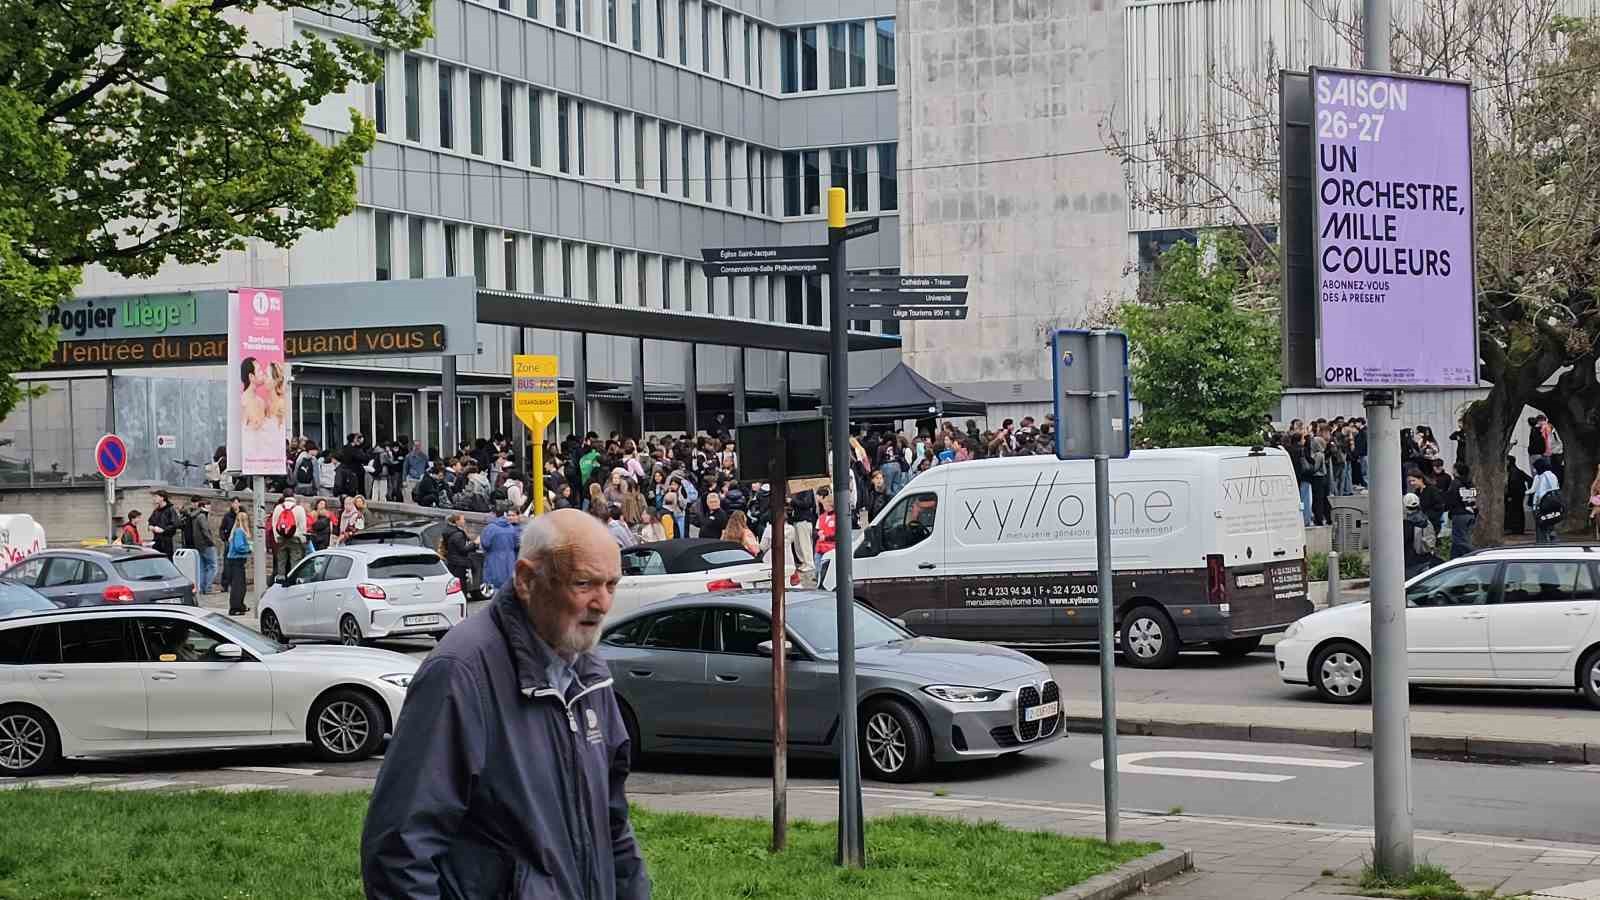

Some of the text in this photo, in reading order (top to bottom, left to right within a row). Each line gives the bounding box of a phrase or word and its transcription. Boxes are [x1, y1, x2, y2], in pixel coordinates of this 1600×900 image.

[1318, 75, 1408, 111] SAISON
[1319, 110, 1385, 142] 26-27
[1320, 143, 1357, 173] UN
[1320, 177, 1465, 216] ORCHESTRE,
[1321, 211, 1397, 242] MILLE
[720, 248, 777, 259] Église Saint-Jacques
[774, 264, 817, 272] Philharmonique
[1321, 245, 1451, 277] COULEURS
[1322, 279, 1390, 291] ABONNEZ-VOUS
[120, 297, 181, 334] Liège
[187, 297, 198, 325] 1
[63, 339, 145, 363] l'entrée
[152, 337, 181, 360] du
[284, 330, 358, 355] quand
[365, 331, 425, 350] vous
[516, 361, 540, 373] Zone
[1323, 366, 1363, 384] OPRL
[517, 379, 535, 389] BUS
[977, 586, 987, 597] 32
[988, 586, 994, 596] 4
[994, 586, 1009, 596] 233
[1010, 586, 1020, 596] 94
[1021, 586, 1031, 596] 34
[1039, 585, 1045, 595] F
[1052, 585, 1062, 595] 32
[1063, 585, 1070, 595] 4
[1070, 585, 1086, 595] 234
[1086, 584, 1098, 594] 00
